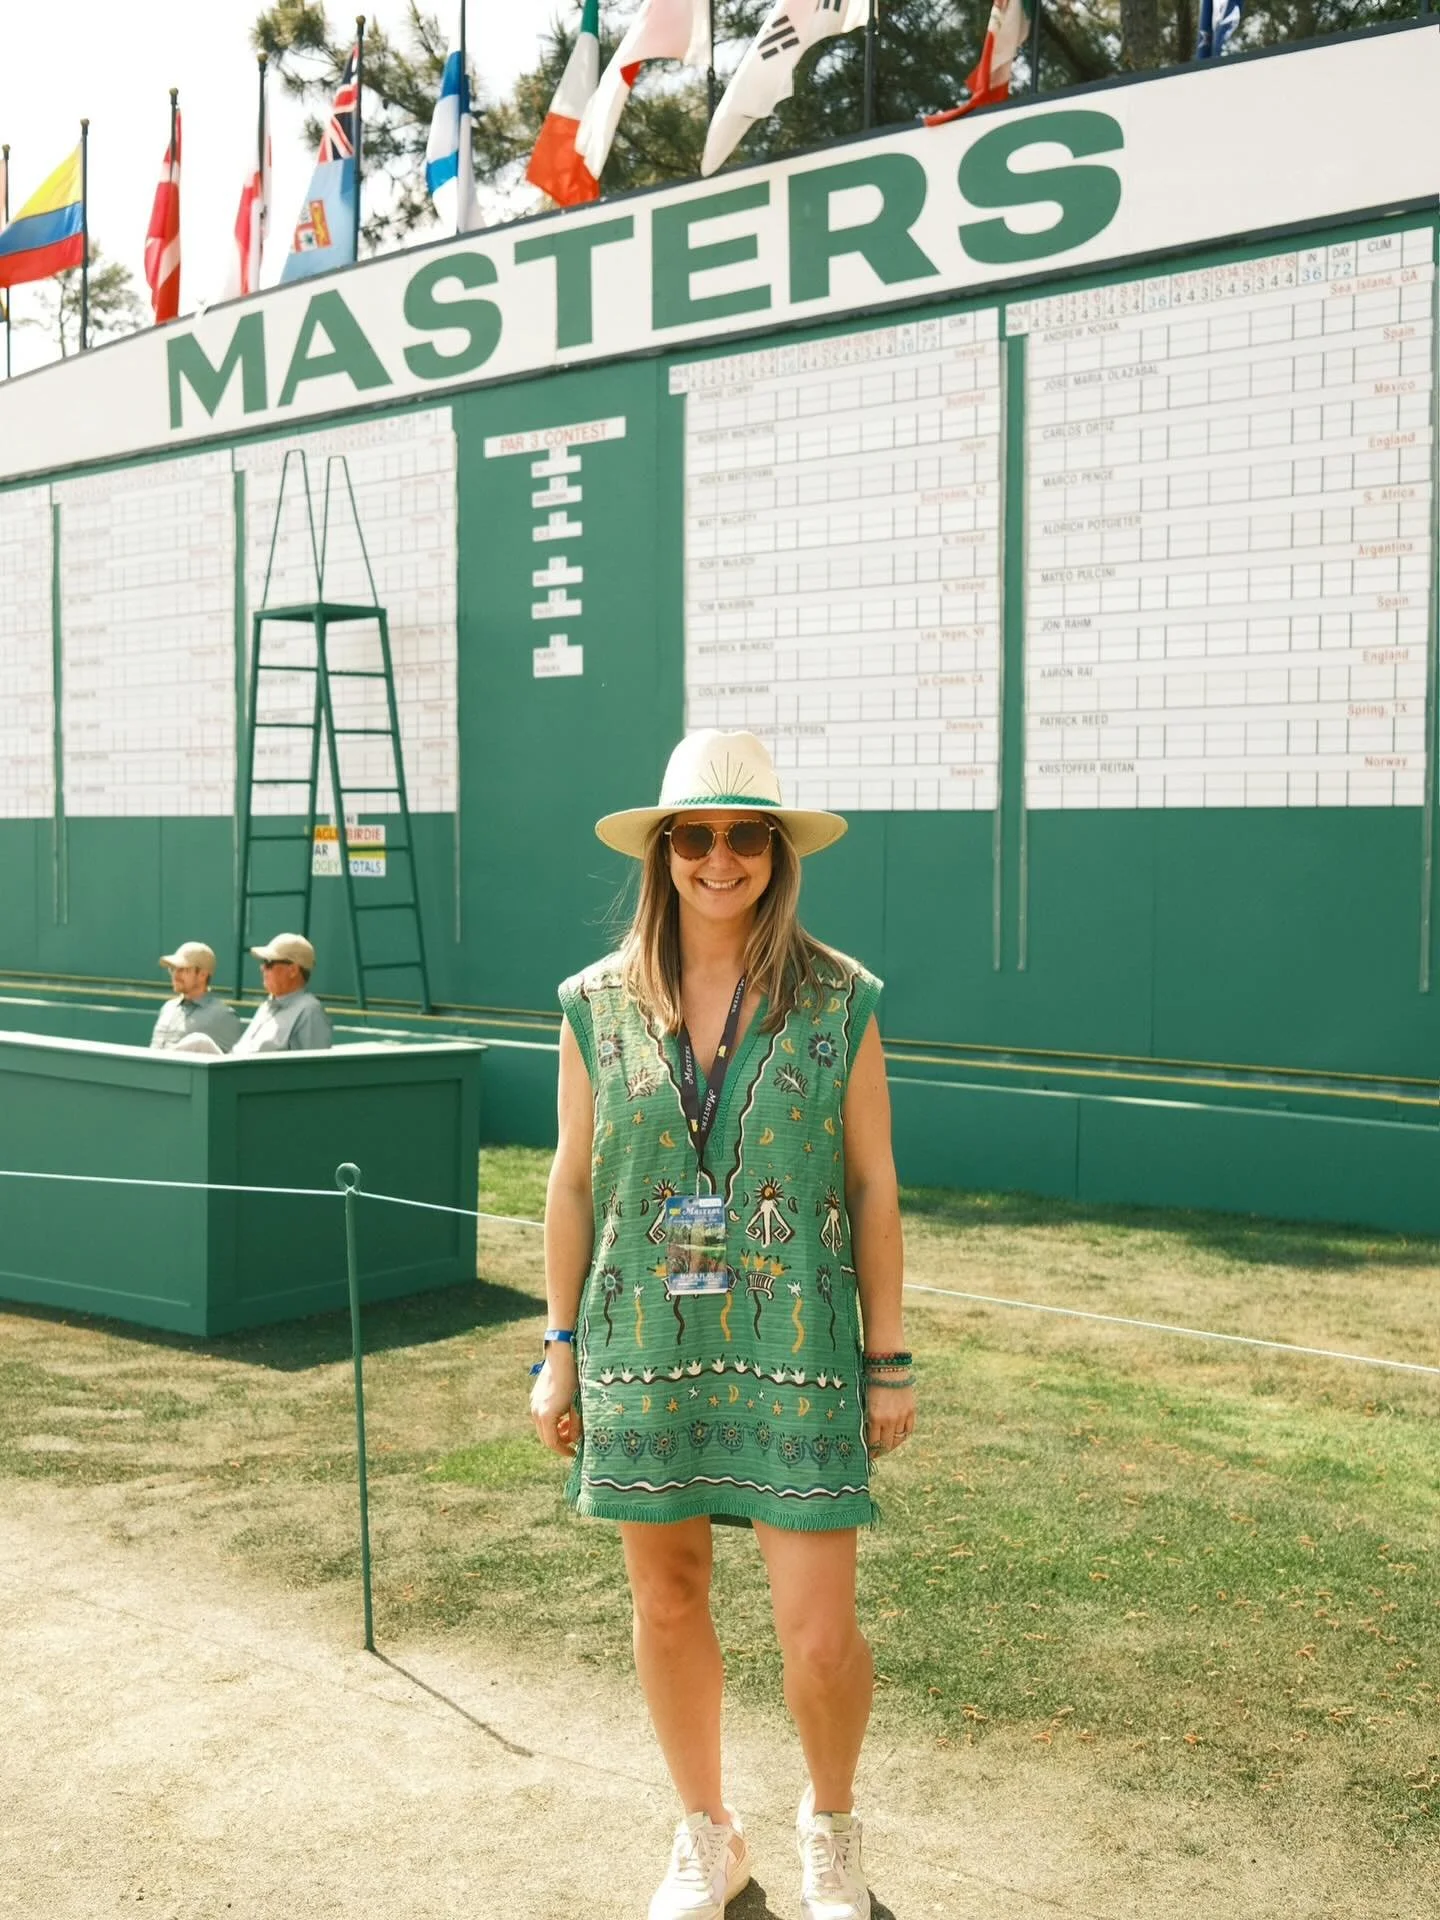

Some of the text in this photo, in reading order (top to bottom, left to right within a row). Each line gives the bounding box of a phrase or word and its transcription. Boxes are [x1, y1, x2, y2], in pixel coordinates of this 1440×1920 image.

[1367, 238, 1391, 253] CUM
[166, 109, 1125, 430] MASTERS
[1302, 266, 1322, 281] 36
[1333, 262, 1351, 277] 72
[1330, 283, 1352, 295] Sea
[1401, 270, 1418, 282] GA
[1383, 326, 1416, 342] Spain
[1043, 374, 1071, 391] JOSE
[1374, 378, 1416, 394] Mexico
[1042, 420, 1115, 439] CARLOS ORTIZ
[500, 424, 608, 453] PAR 3 CONTEST
[1368, 431, 1416, 450] England
[1042, 469, 1115, 487] MARCO PENGE
[1381, 485, 1416, 500] Africa
[1042, 519, 1084, 535] ALDRICH
[1357, 540, 1413, 557] Argentina
[1041, 567, 1116, 584] MATEO PULCINI
[1376, 594, 1410, 609] Spain
[1041, 617, 1092, 632] JON RAHM
[1362, 648, 1410, 664] England
[1040, 666, 1093, 680] AARON RAI
[1347, 701, 1408, 719] Spring, TX
[1039, 713, 1109, 727] PATRICK REED
[1038, 761, 1135, 776] KRISTOFFER REITAN
[1364, 755, 1408, 769] Norway
[314, 844, 329, 856] AR
